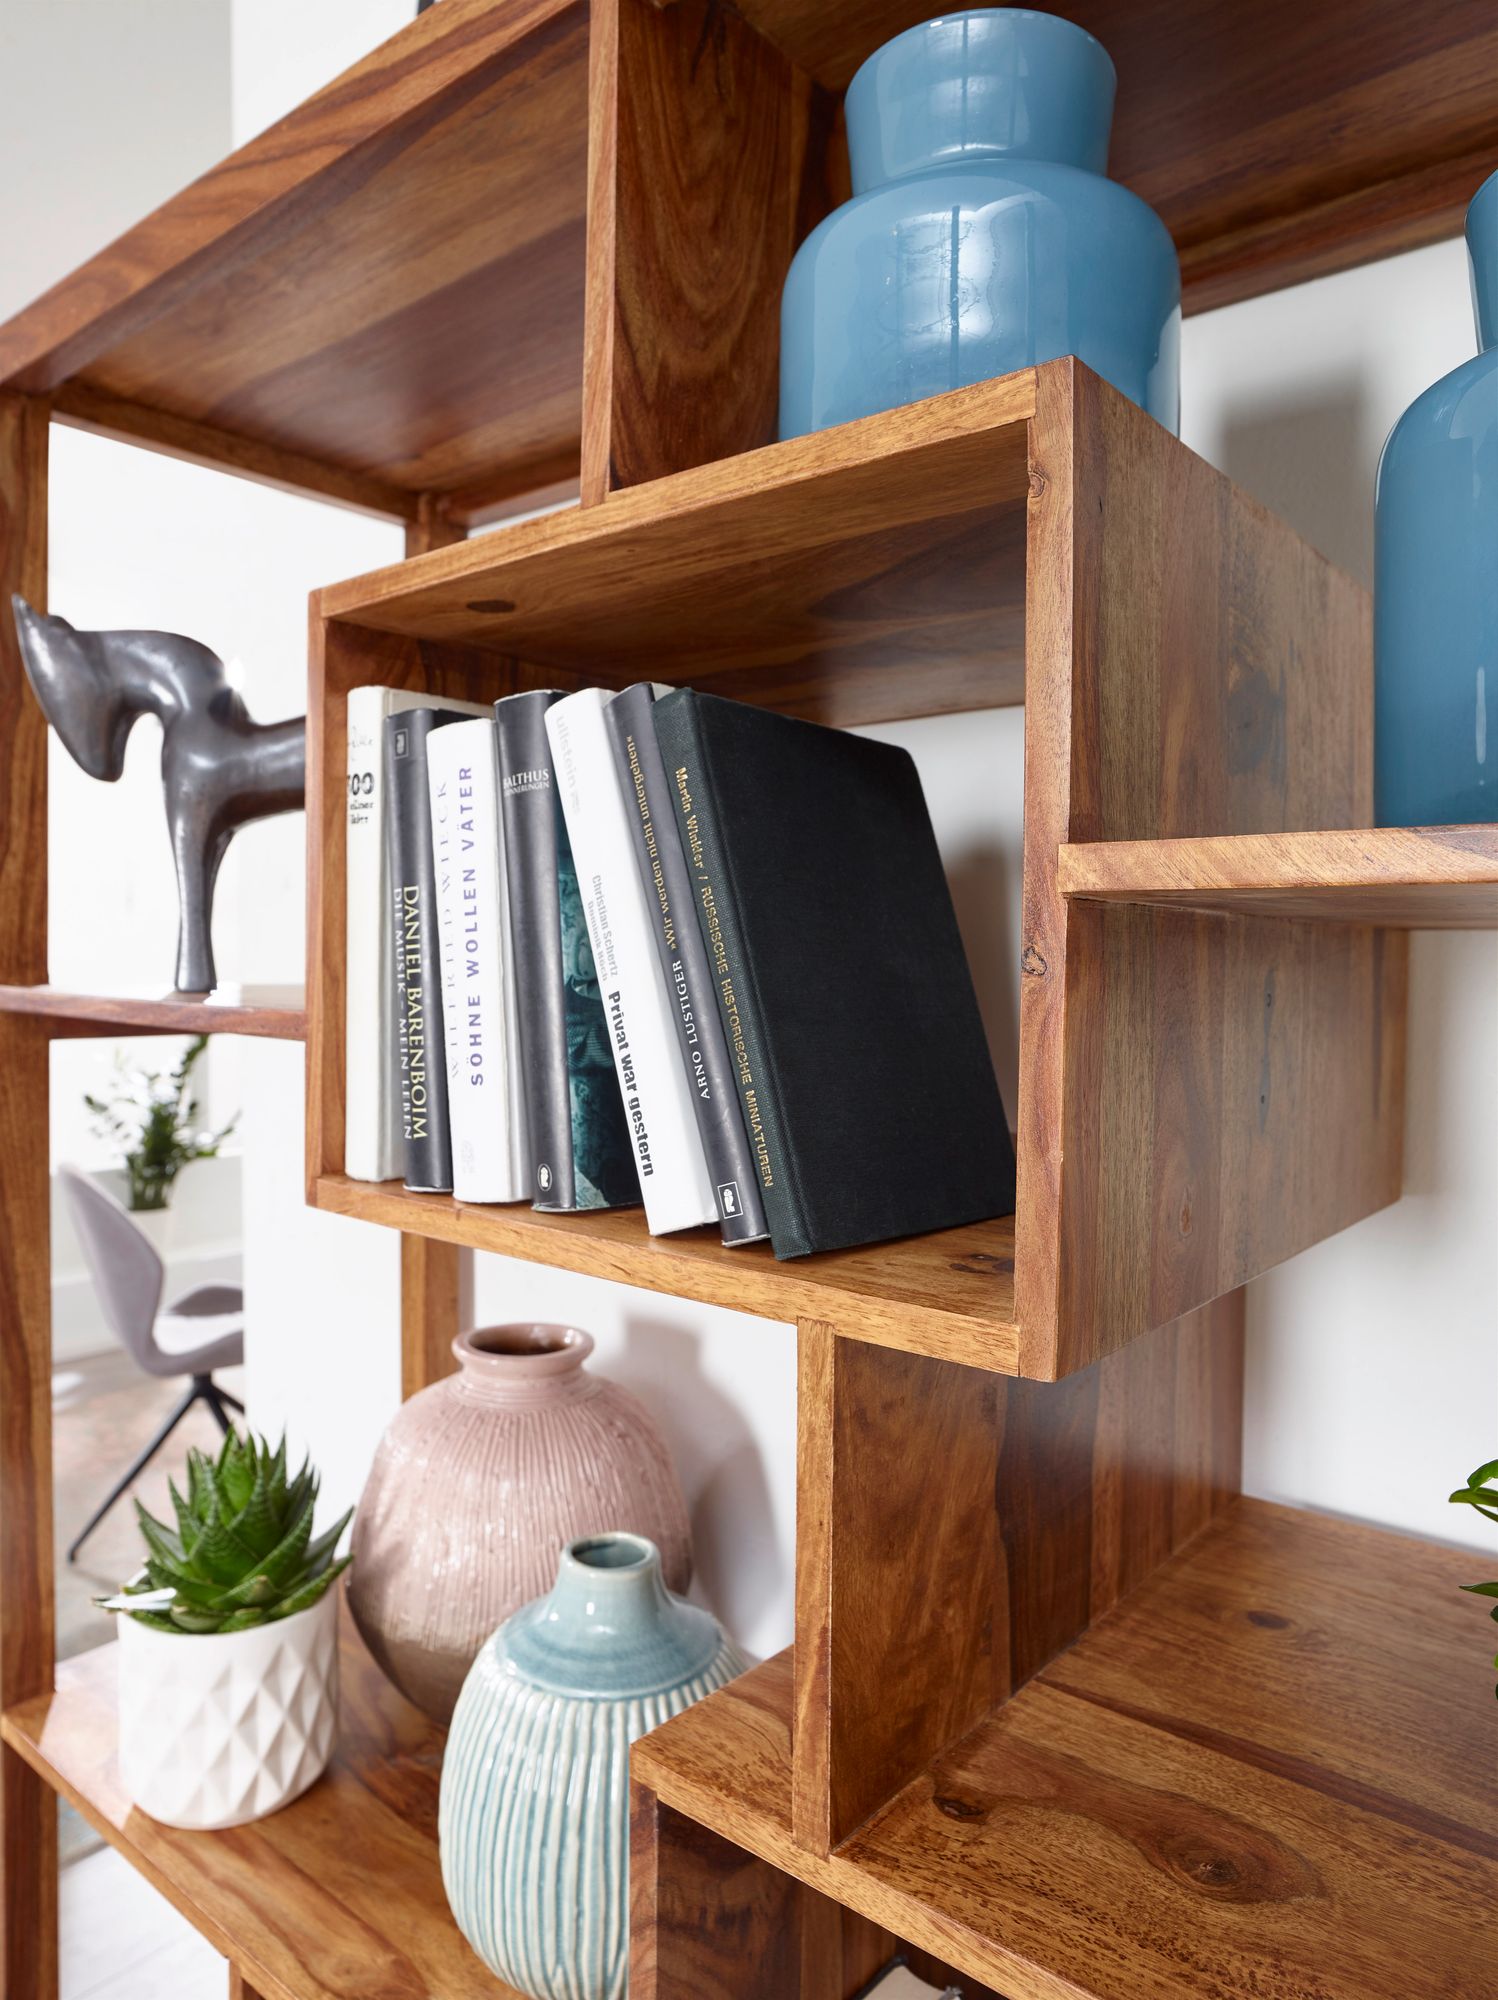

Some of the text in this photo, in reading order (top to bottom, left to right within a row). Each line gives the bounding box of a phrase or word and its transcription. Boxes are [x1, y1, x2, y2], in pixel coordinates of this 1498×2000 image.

[643, 822, 658, 858] nicht
[393, 888, 403, 920] DIE
[652, 860, 669, 914] werden
[456, 767, 484, 1086] SÖHNE WOLLEN VÄTER
[587, 901, 601, 949] Dominik
[592, 875, 619, 976] Christian Schertz
[395, 930, 406, 994] MUSIK
[675, 767, 692, 813] Martin
[687, 815, 704, 869] Winkler
[701, 886, 730, 975] RUSSISCHE
[721, 978, 753, 1084] HISTORISCHE
[745, 1089, 774, 1188] MINIATUREN
[403, 886, 428, 1139] DANIEL BARENBOIM
[672, 960, 698, 1044] LUSTIGER
[399, 1018, 409, 1070] MEIN
[608, 990, 654, 1177] Privat war gestern
[692, 1051, 711, 1099] ARNO
[402, 1080, 412, 1139] LEBEN
